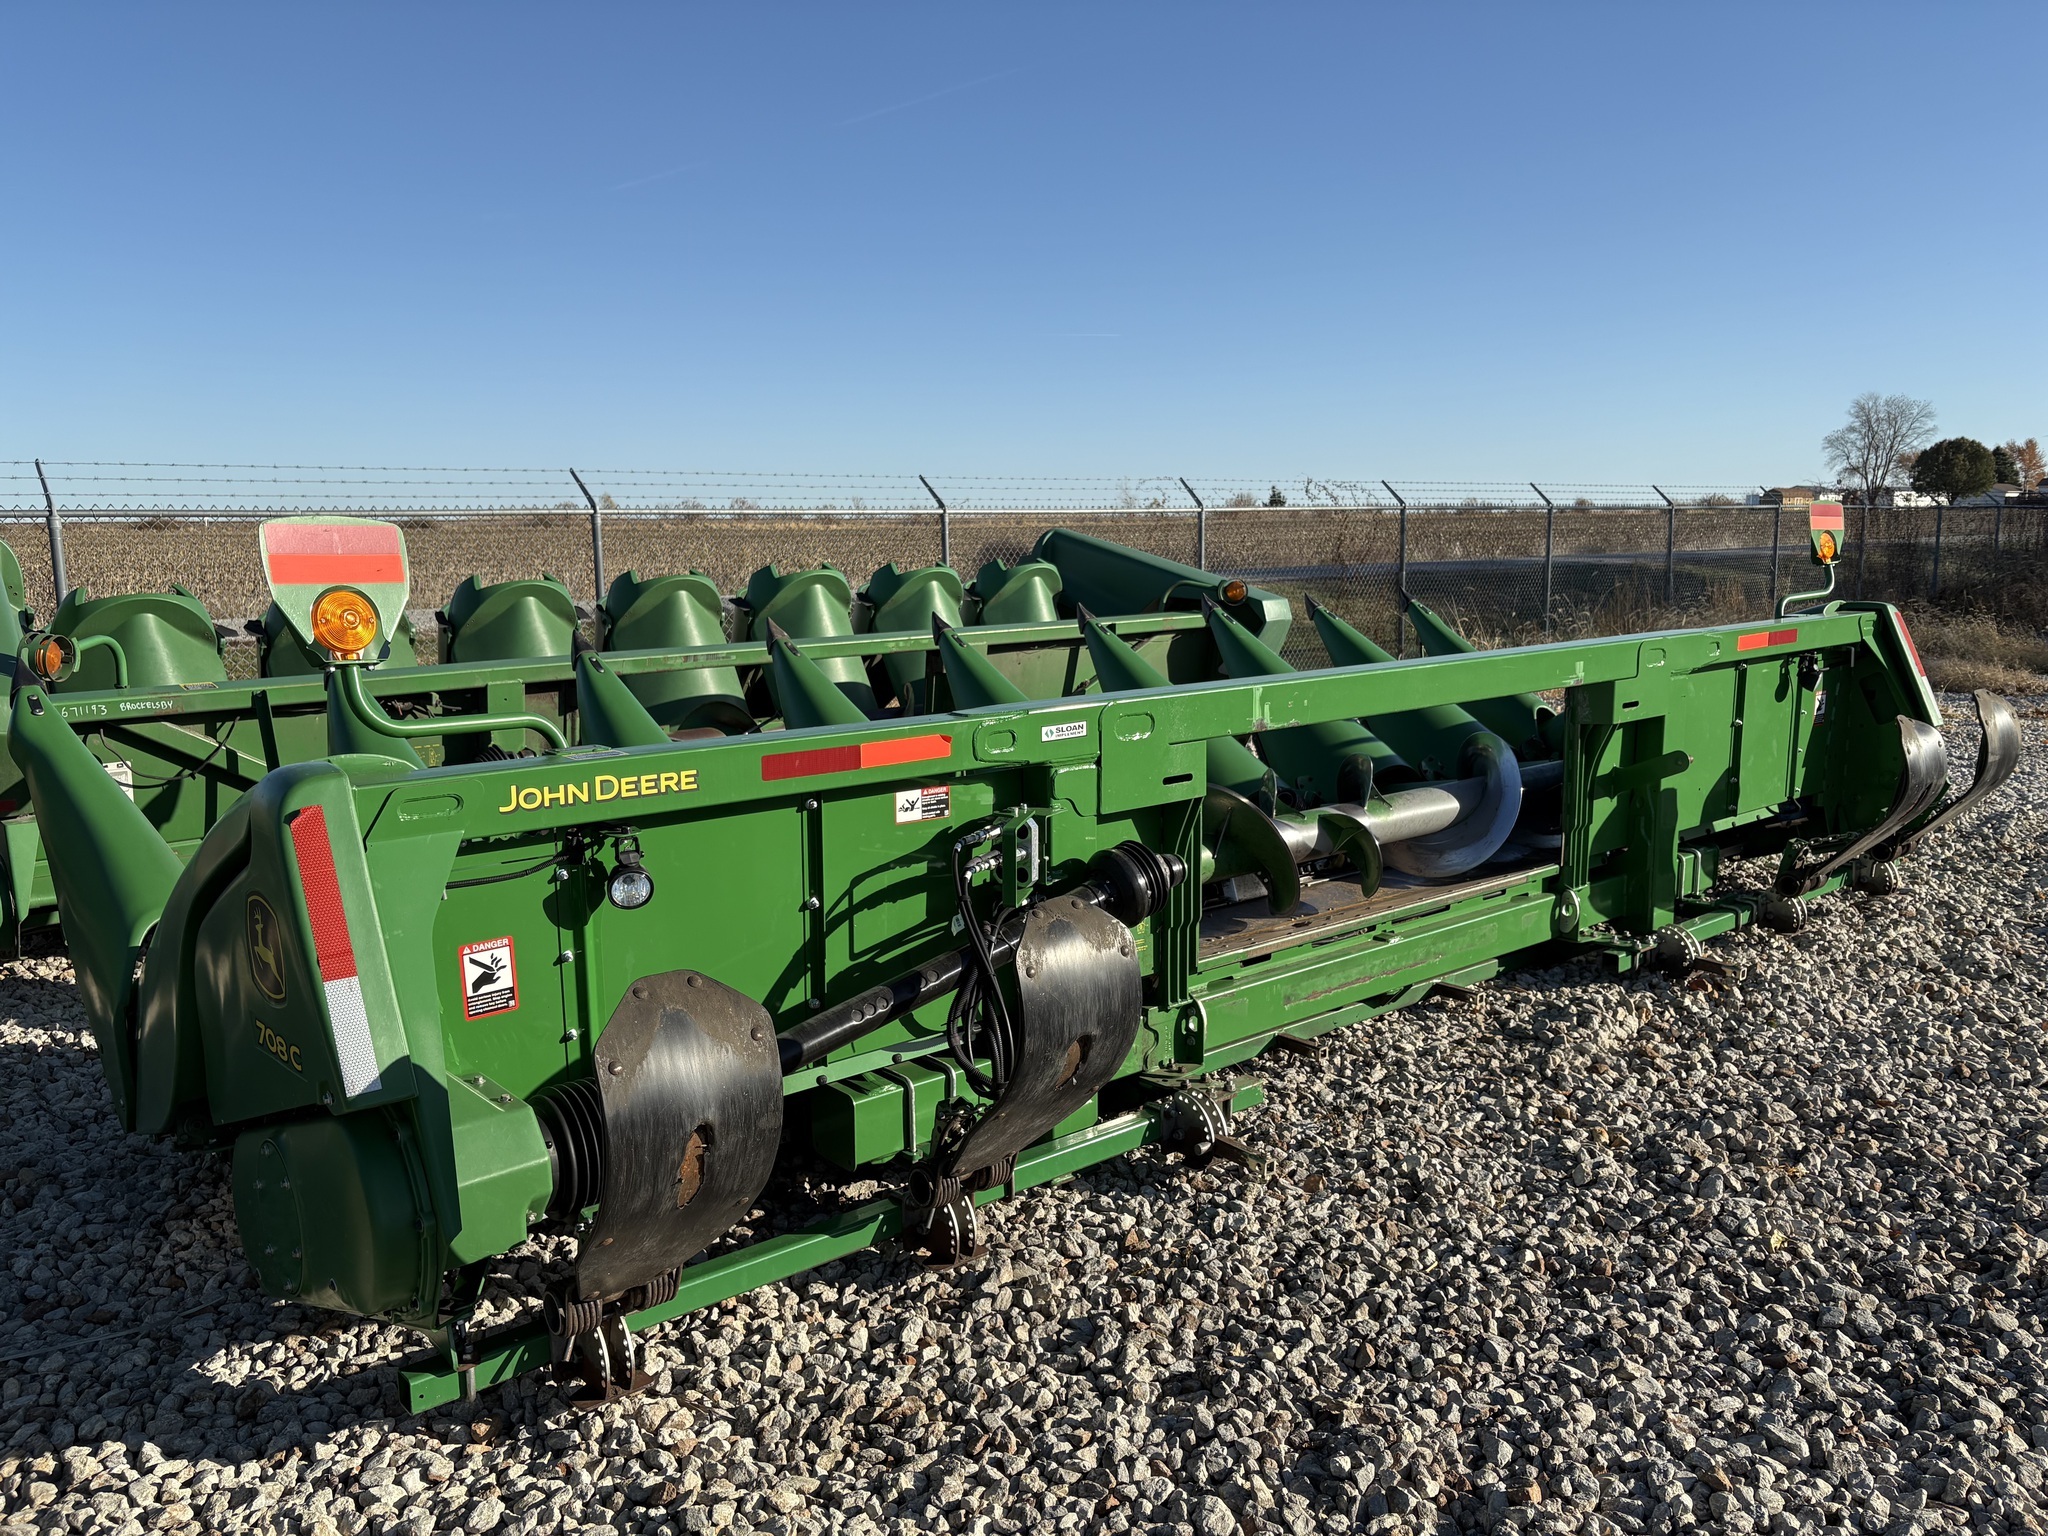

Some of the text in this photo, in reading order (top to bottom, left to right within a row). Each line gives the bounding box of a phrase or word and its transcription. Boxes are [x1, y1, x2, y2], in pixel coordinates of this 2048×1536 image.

[61, 700, 174, 718] 671193 BROCKELSBY
[1055, 723, 1084, 734] SLOAN
[498, 769, 698, 813] JOHN DEERE
[928, 787, 947, 795] DANGER
[472, 938, 509, 952] DANGER
